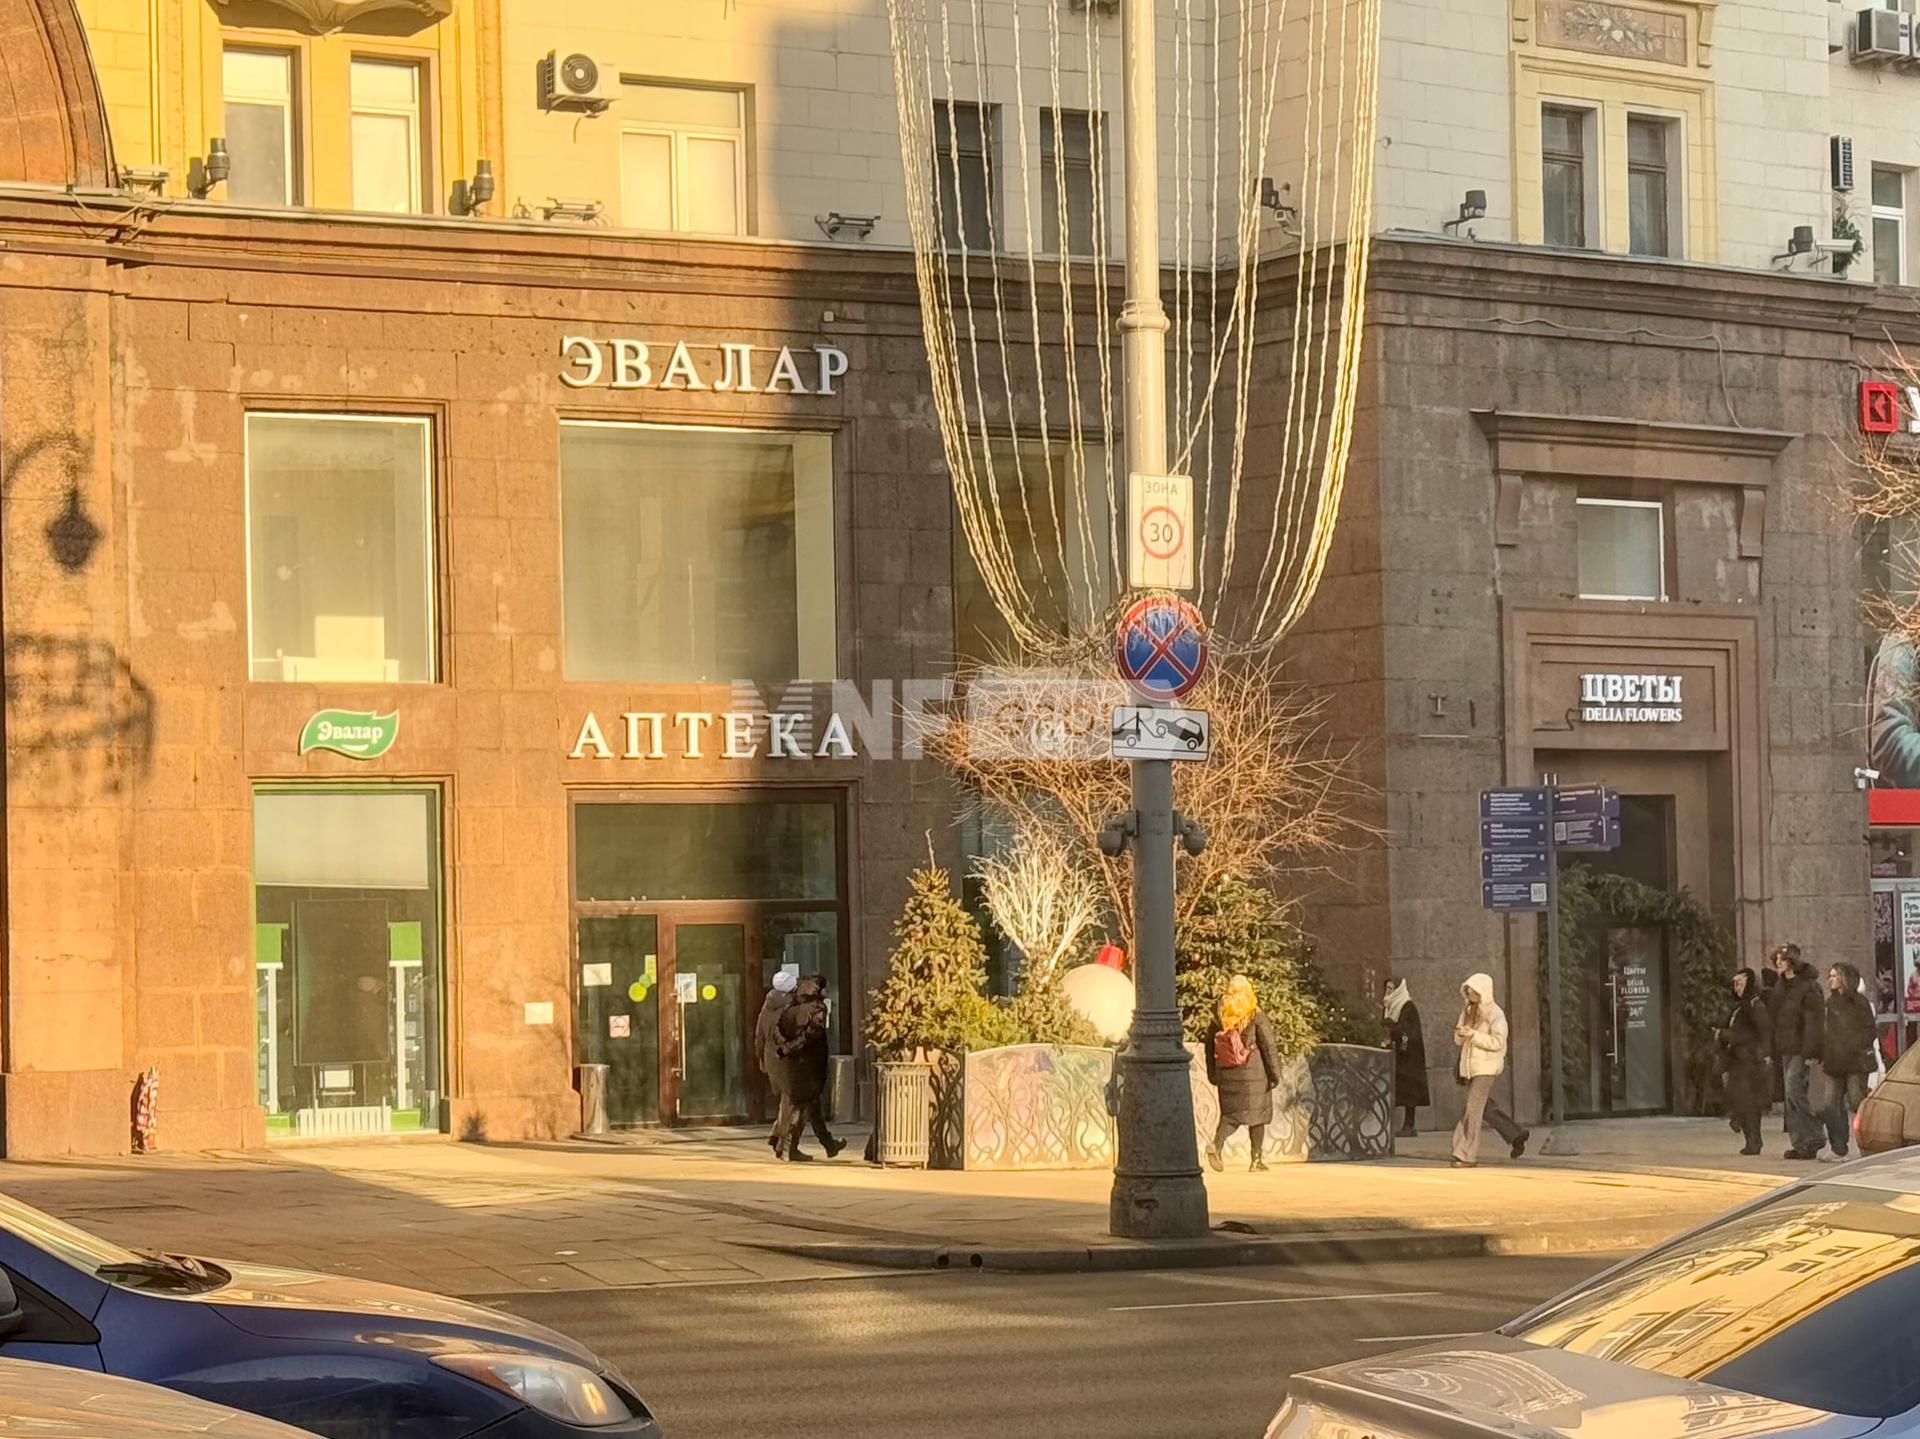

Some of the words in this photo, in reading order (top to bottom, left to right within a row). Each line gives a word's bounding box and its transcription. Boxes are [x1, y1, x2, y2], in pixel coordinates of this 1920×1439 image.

[560, 336, 849, 395] ЭВАЛАР
[1144, 480, 1178, 495] ЗОНА
[1150, 522, 1173, 543] 30
[1580, 674, 1683, 706] ЦВЕТЫ
[1583, 707, 1624, 722] DELIA
[1625, 707, 1683, 722] FLOWERS
[317, 721, 384, 744] Эвалар
[567, 712, 858, 759] АПТЕКА
